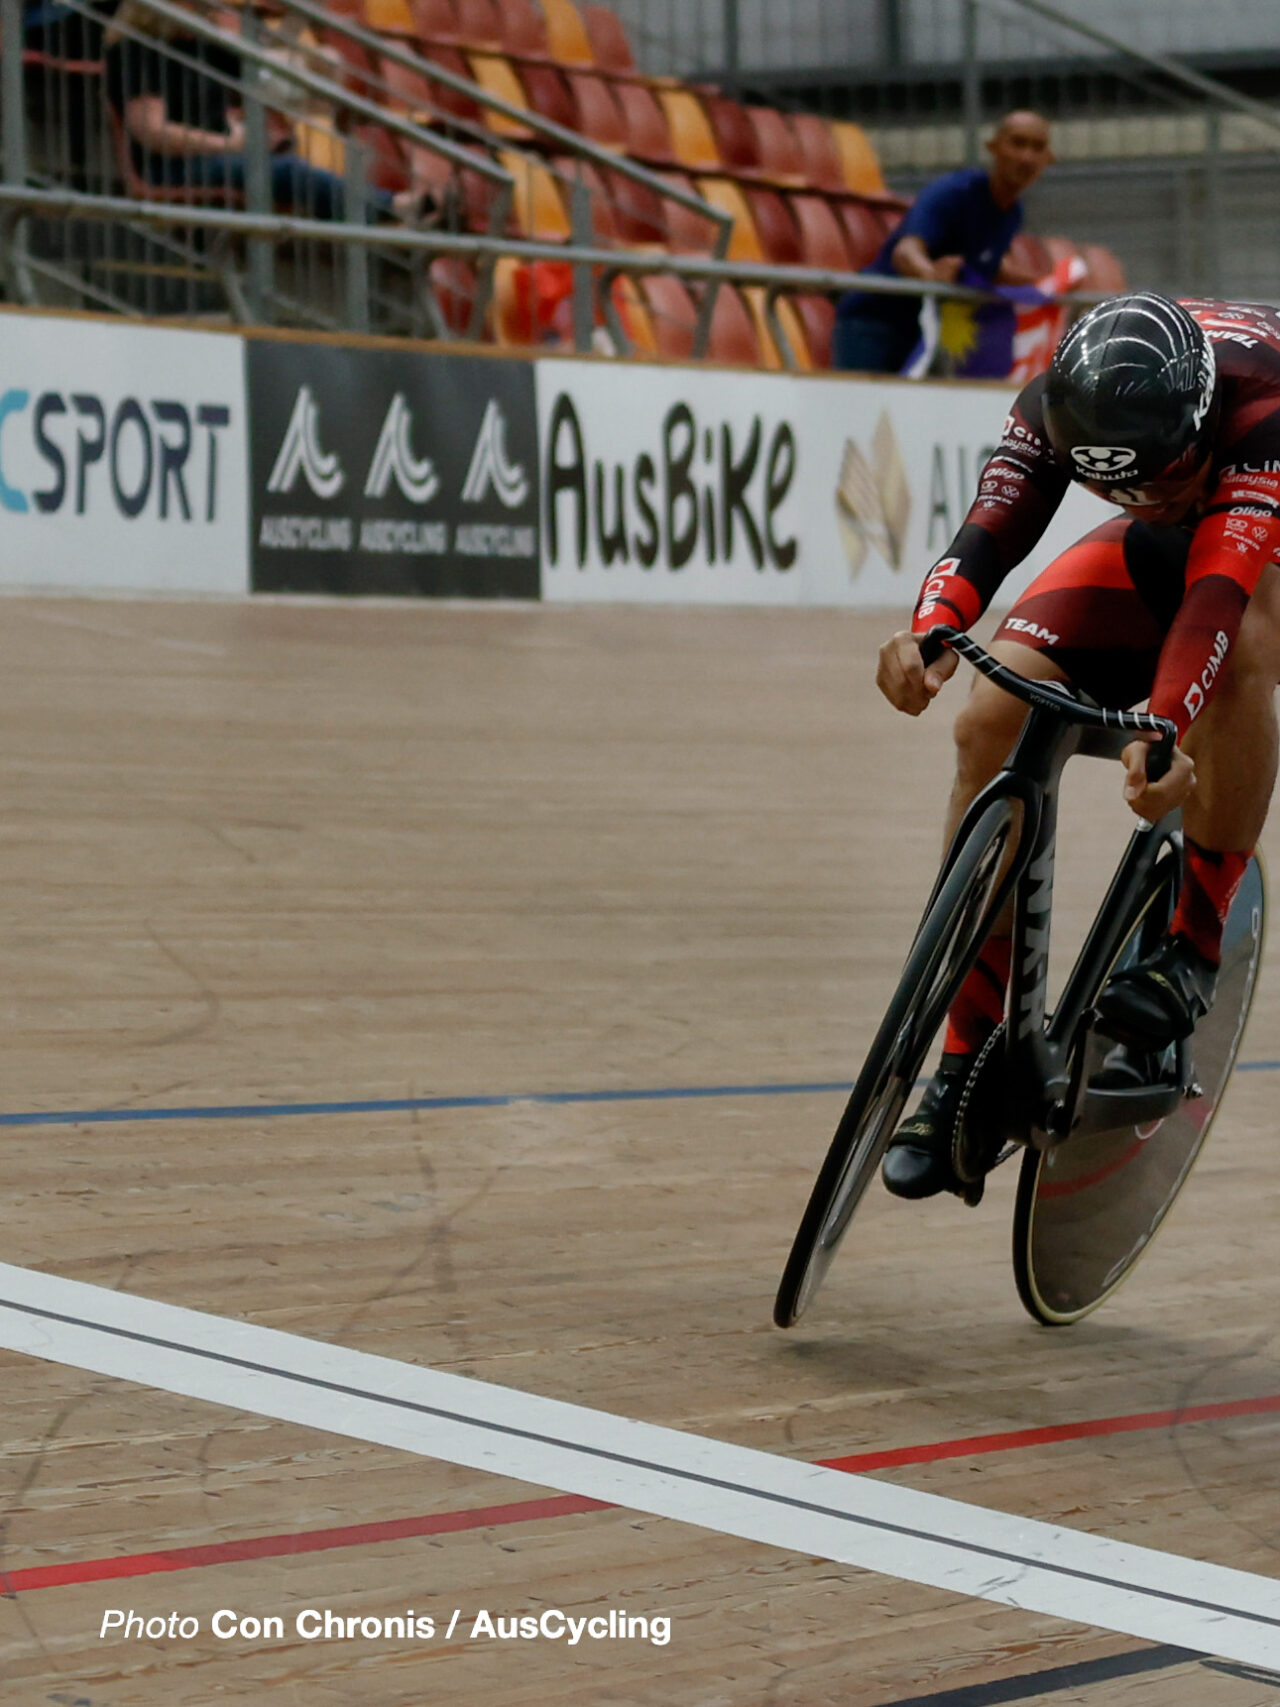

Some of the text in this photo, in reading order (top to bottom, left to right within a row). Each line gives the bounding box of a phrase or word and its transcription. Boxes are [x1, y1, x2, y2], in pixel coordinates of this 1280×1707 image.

[1075, 465, 1139, 481] Kabuto
[1229, 506, 1272, 519] Oligo
[918, 578, 945, 619] CIMB
[1004, 618, 1060, 645] TEAM
[1202, 630, 1229, 690] CIMB
